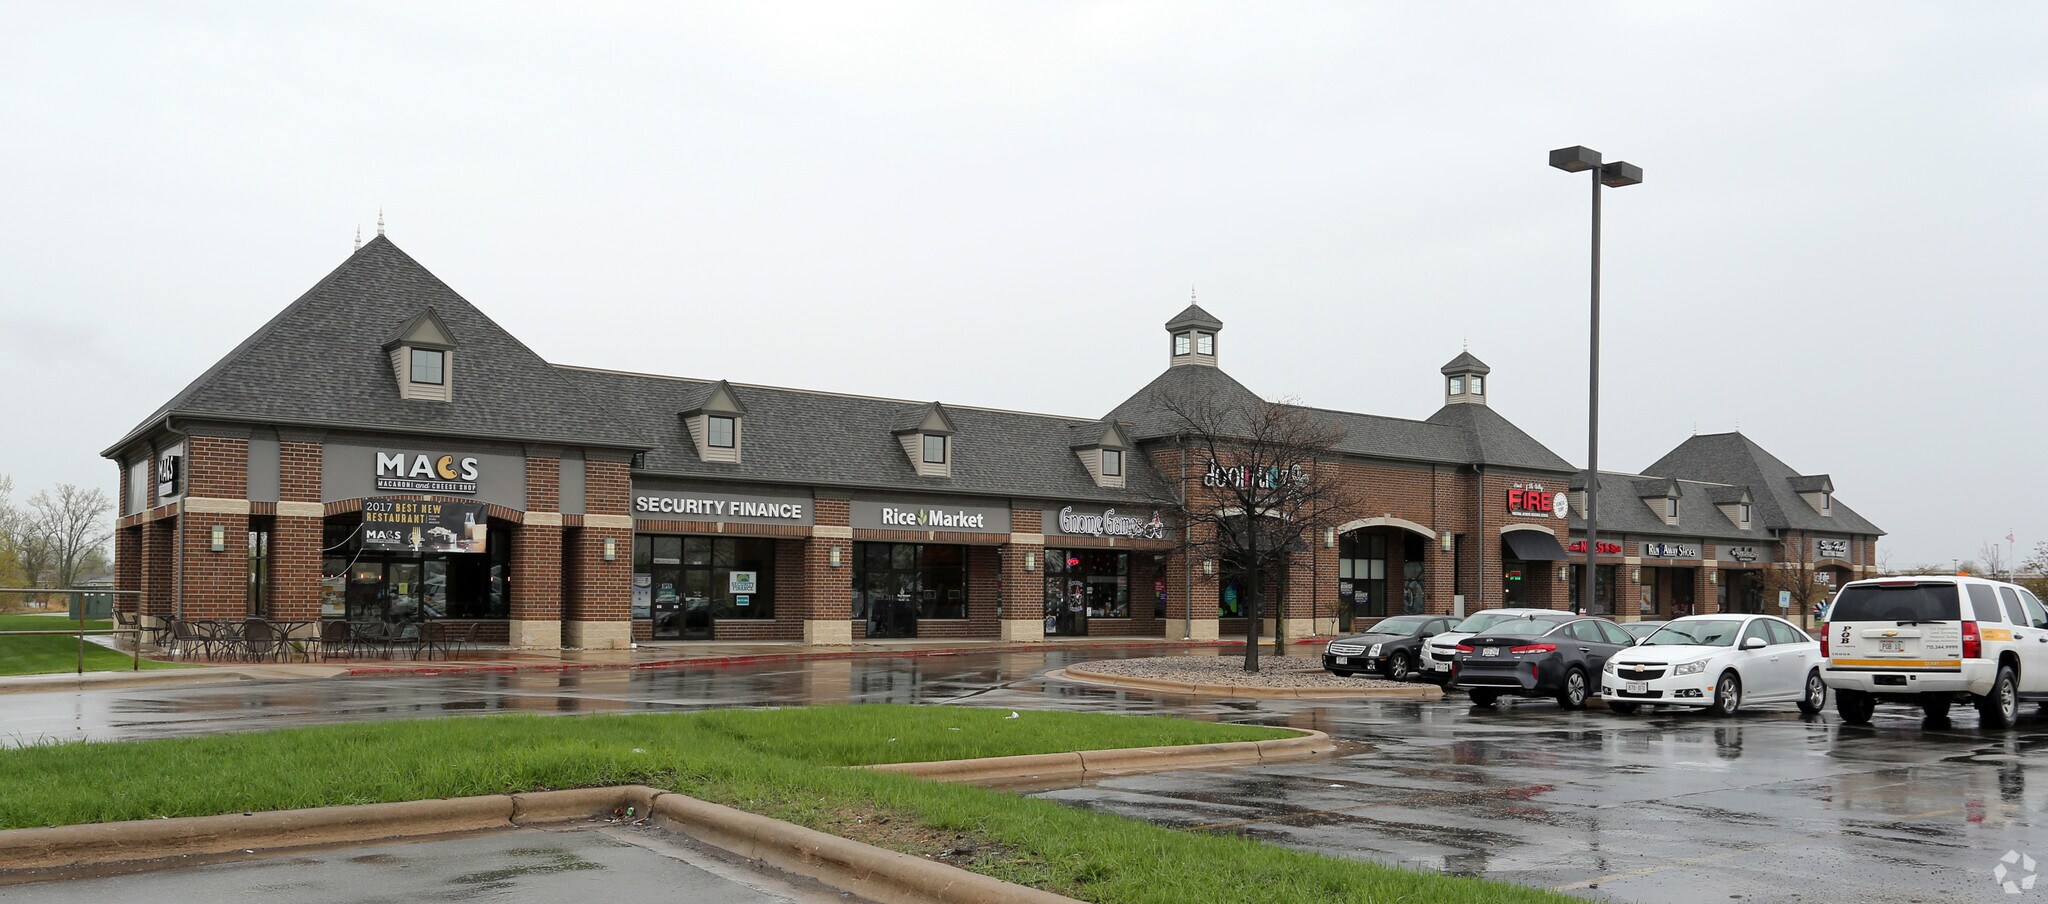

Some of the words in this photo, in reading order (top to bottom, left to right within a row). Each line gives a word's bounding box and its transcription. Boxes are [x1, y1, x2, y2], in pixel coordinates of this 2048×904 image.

[376, 452, 479, 481] MACS
[377, 480, 414, 488] MACARONI
[366, 502, 392, 512] 2017
[395, 503, 417, 513] BEST
[421, 504, 442, 514] NEW
[636, 496, 726, 515] SECURITY
[728, 501, 802, 519] FINANCE
[1508, 489, 1553, 512] FIRE
[366, 512, 425, 523] RESTAURANT
[882, 507, 916, 525] Rice
[928, 510, 984, 528] Market
[1059, 506, 1104, 537] Gnome
